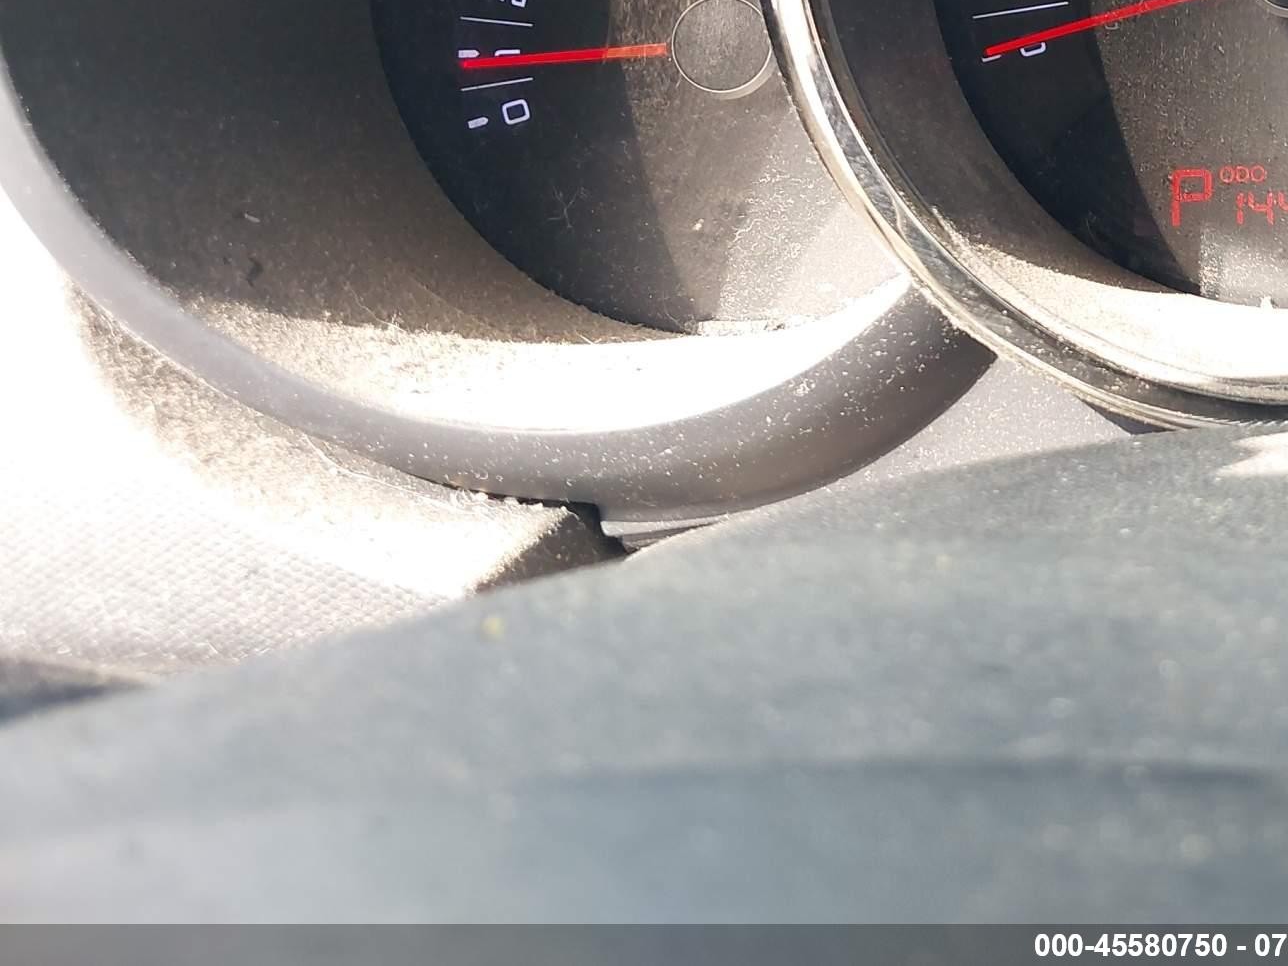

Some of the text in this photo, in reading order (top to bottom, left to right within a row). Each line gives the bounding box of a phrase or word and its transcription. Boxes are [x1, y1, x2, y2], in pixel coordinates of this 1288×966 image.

[501, 98, 531, 126] 0
[1219, 165, 1267, 183] ODO
[1171, 167, 1213, 227] P
